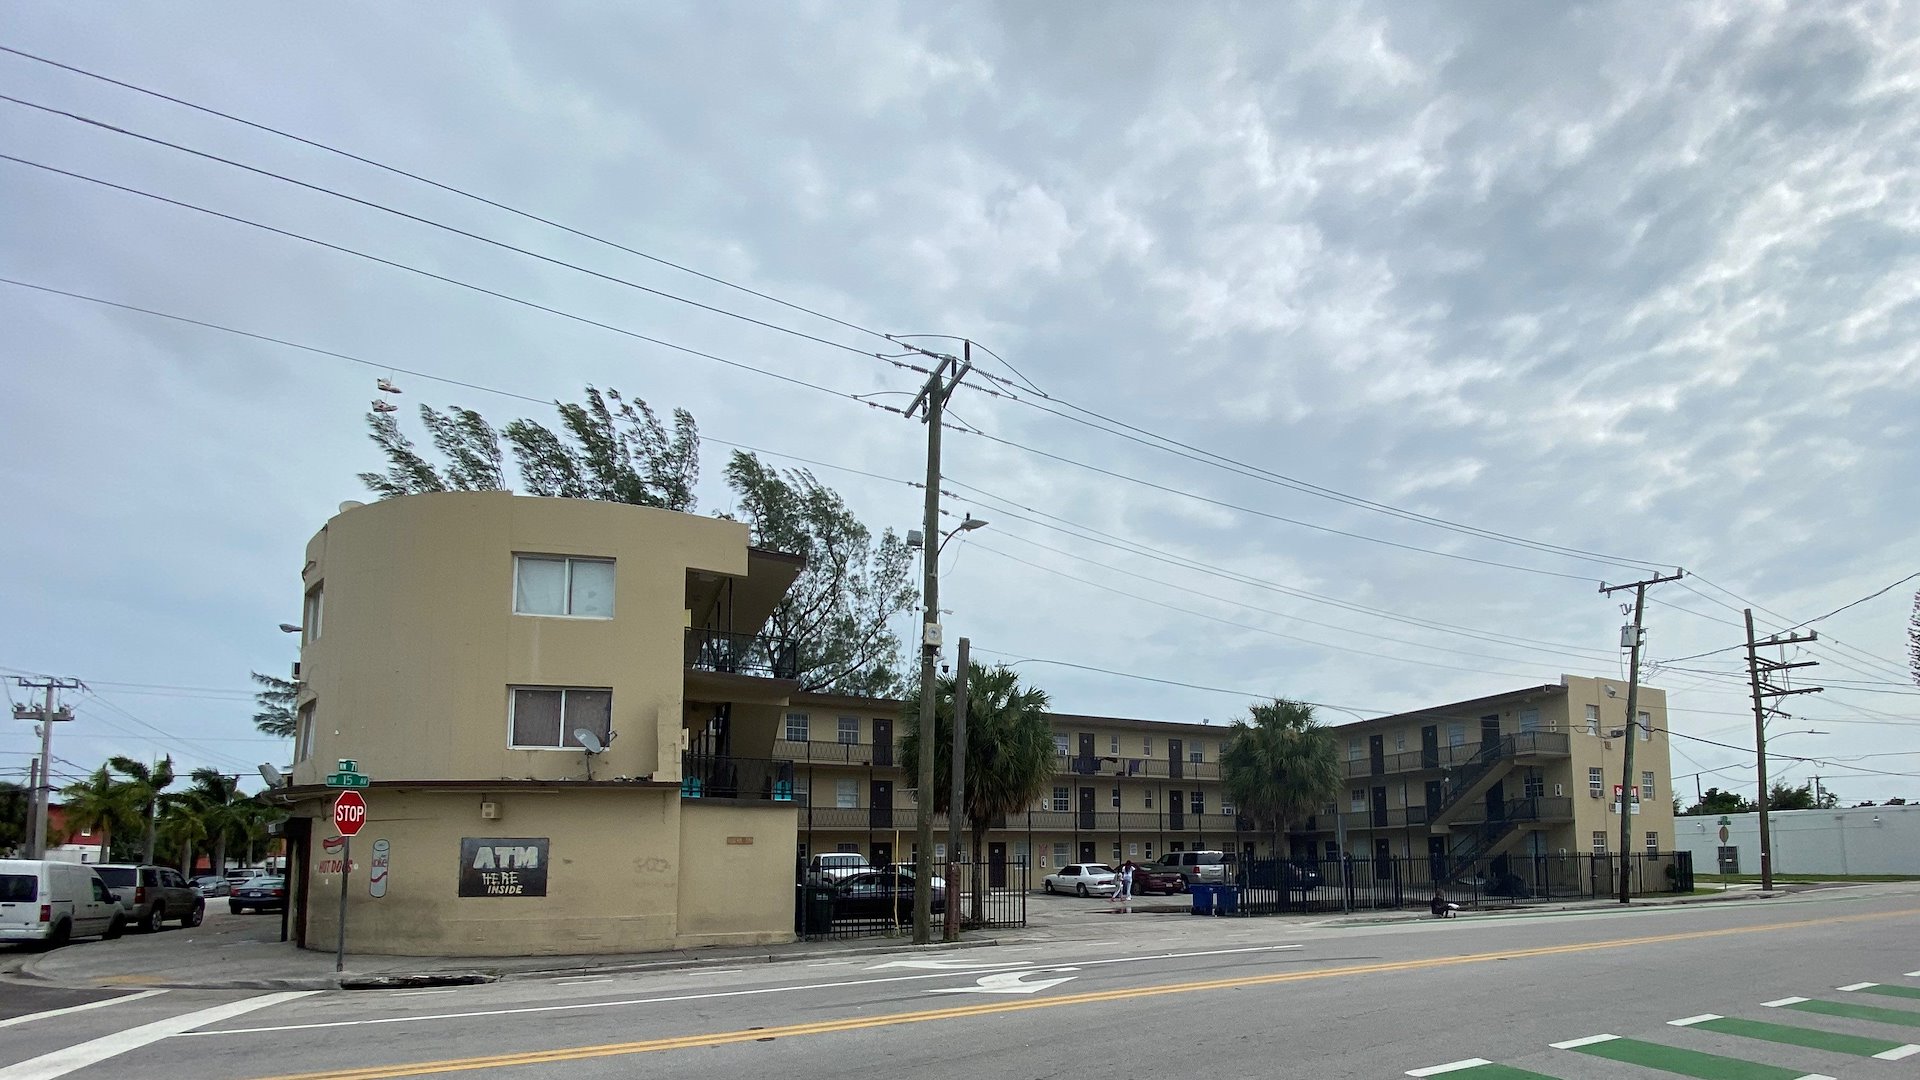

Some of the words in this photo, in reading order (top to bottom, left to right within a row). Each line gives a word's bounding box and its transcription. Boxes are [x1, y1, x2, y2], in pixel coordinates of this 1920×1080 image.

[343, 775, 353, 785] 15
[336, 805, 364, 822] STOP
[473, 846, 539, 869] ATM
[331, 859, 353, 874] DOS
[482, 871, 520, 885] HERE
[487, 885, 524, 895] INSIDE
